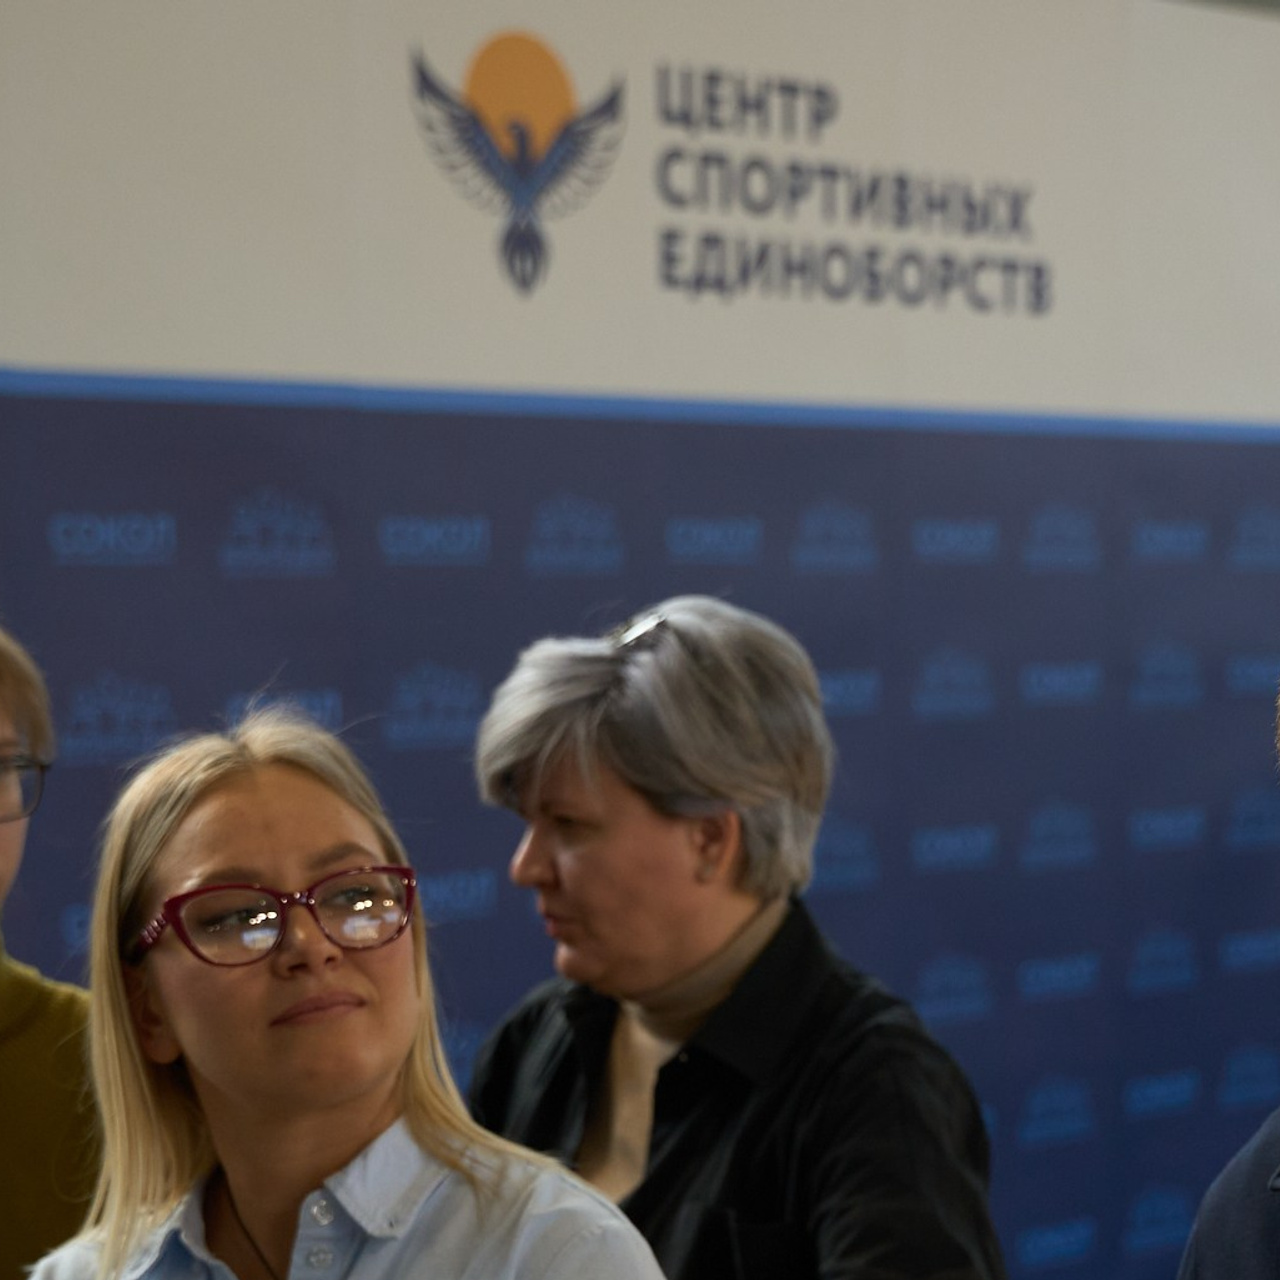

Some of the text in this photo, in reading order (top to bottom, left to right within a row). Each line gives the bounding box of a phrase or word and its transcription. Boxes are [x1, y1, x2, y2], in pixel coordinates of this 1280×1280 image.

[655, 64, 840, 140] ЦЕНТР
[655, 146, 1034, 240] СПОРТИВНЫХ
[658, 226, 1053, 317] ЕДИНОБОРСТВ
